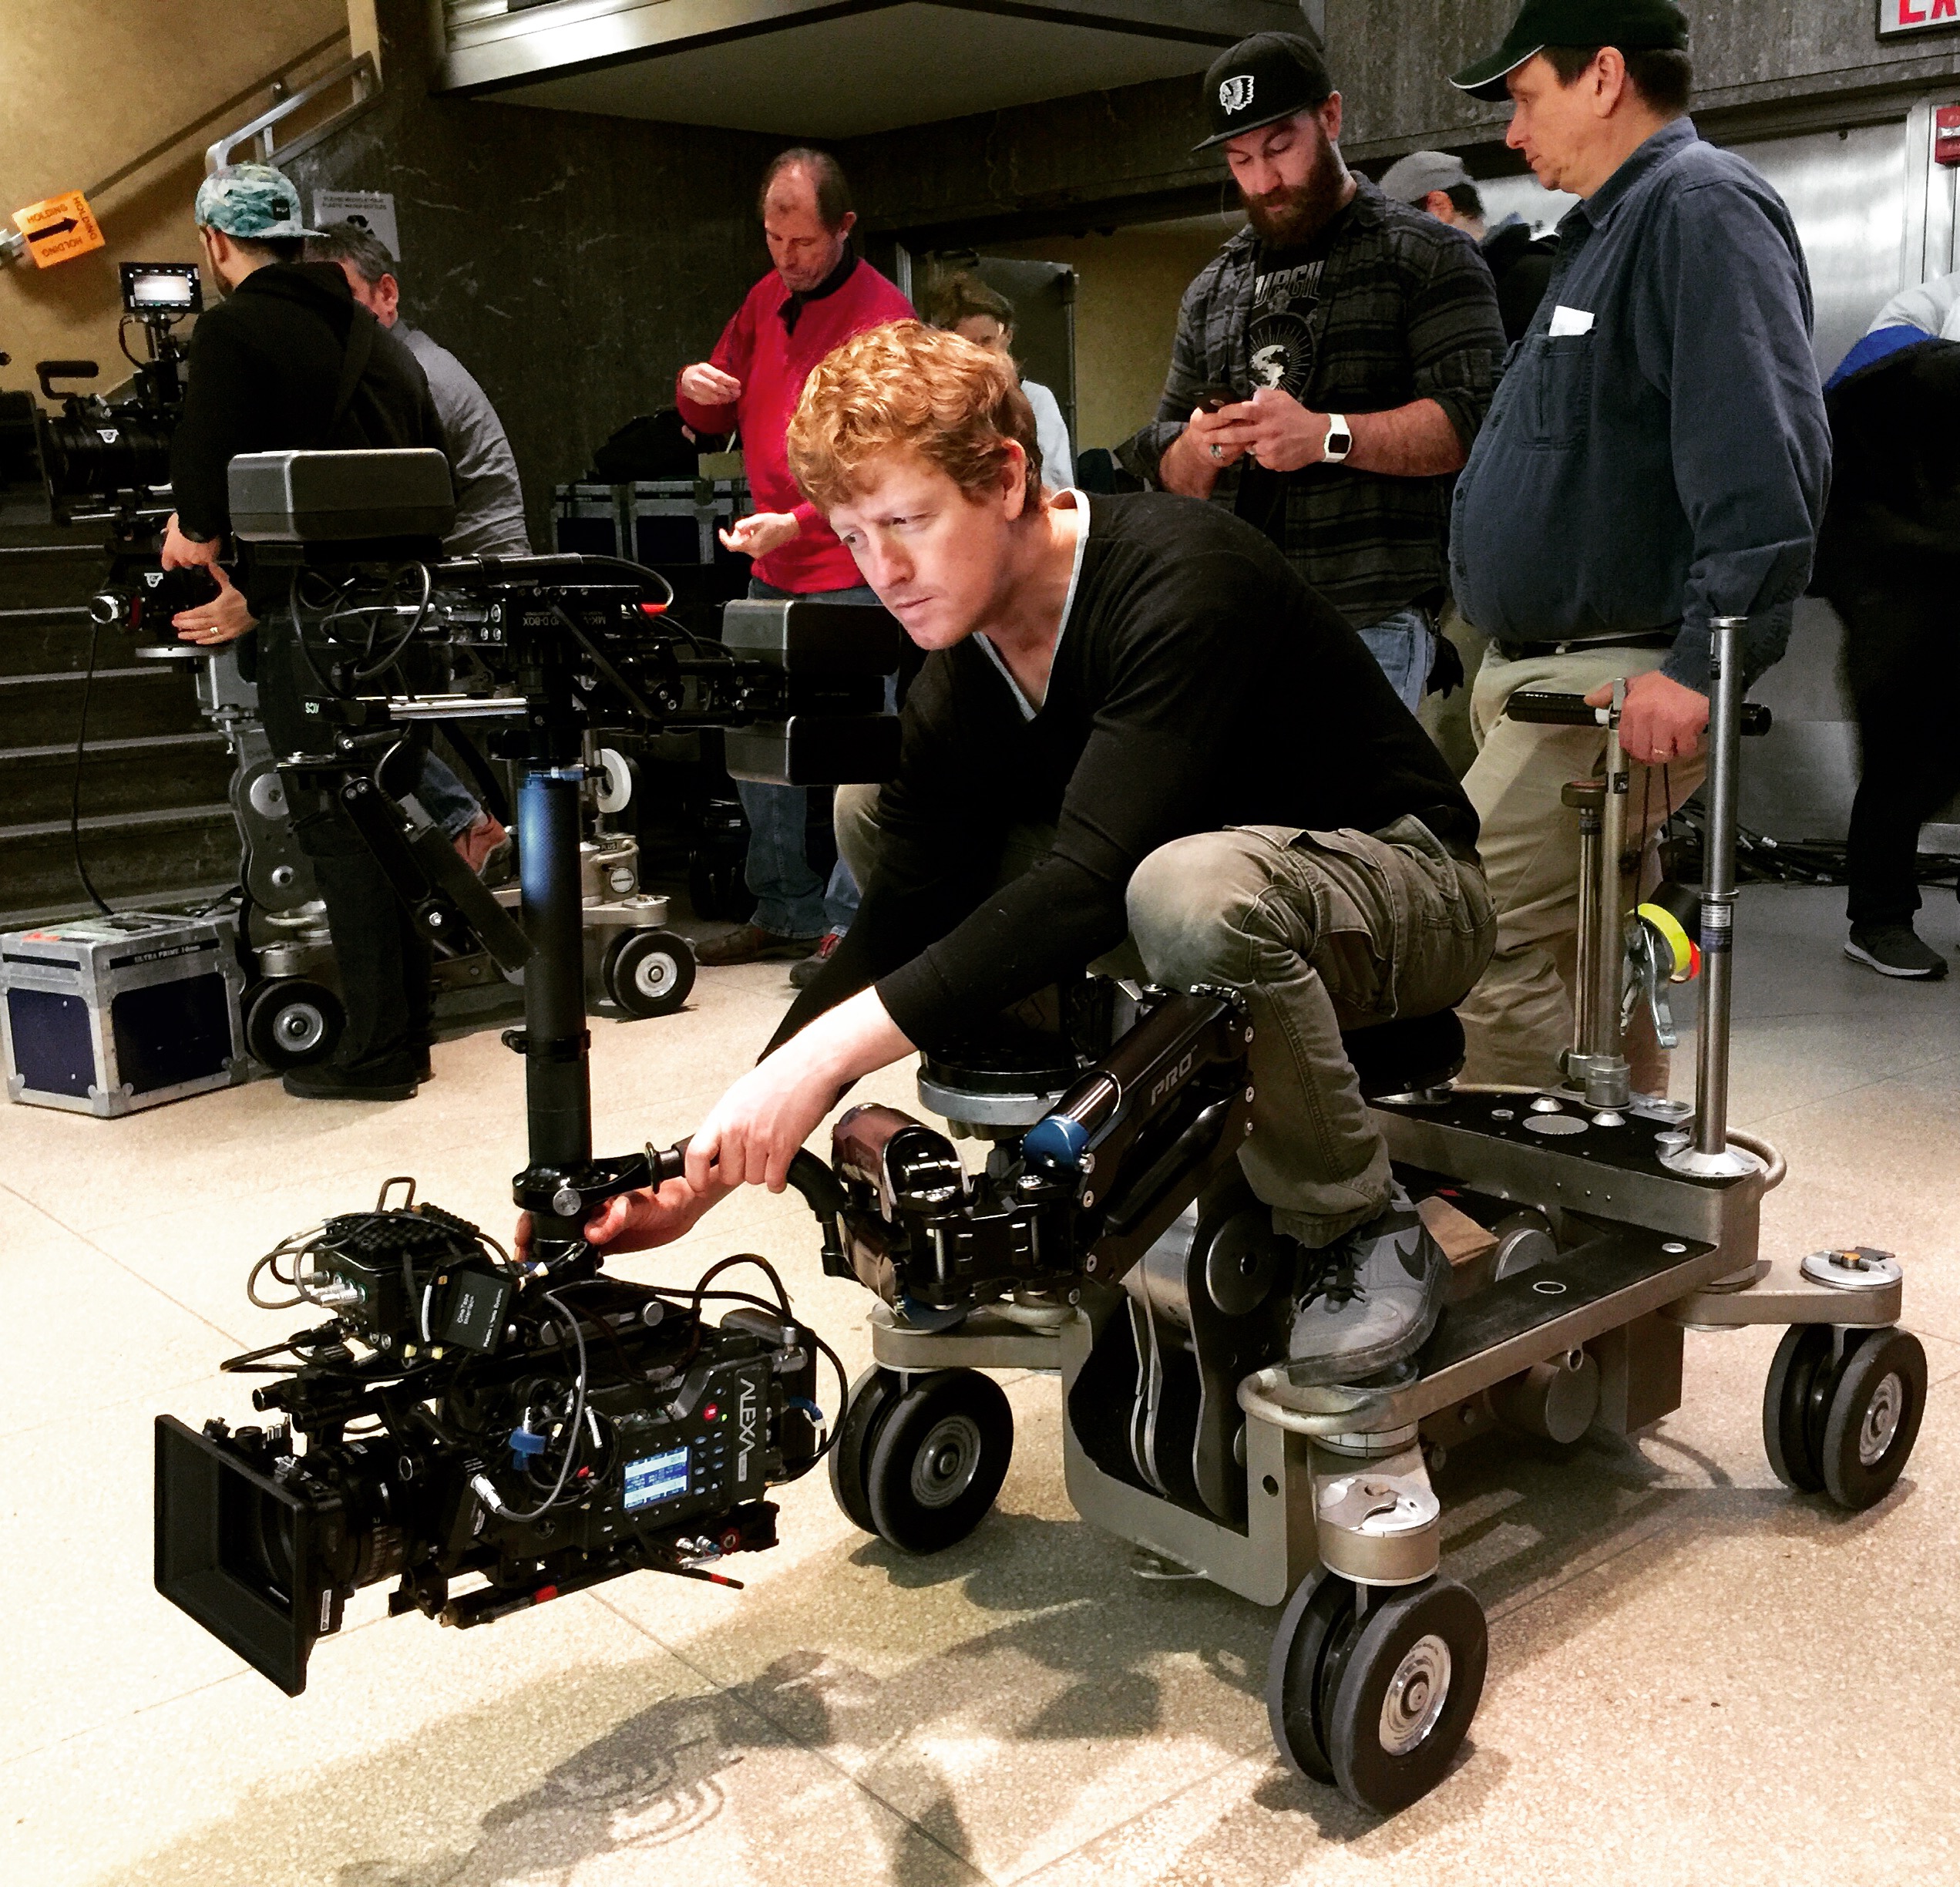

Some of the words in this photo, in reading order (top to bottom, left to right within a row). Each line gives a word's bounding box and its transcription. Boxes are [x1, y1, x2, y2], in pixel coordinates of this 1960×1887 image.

[27, 204, 68, 224] HOLDING
[73, 197, 97, 240] HOLDING
[42, 236, 82, 257] HOLDING
[1151, 1052, 1192, 1106] PRO
[738, 1377, 757, 1458] ALEXA
